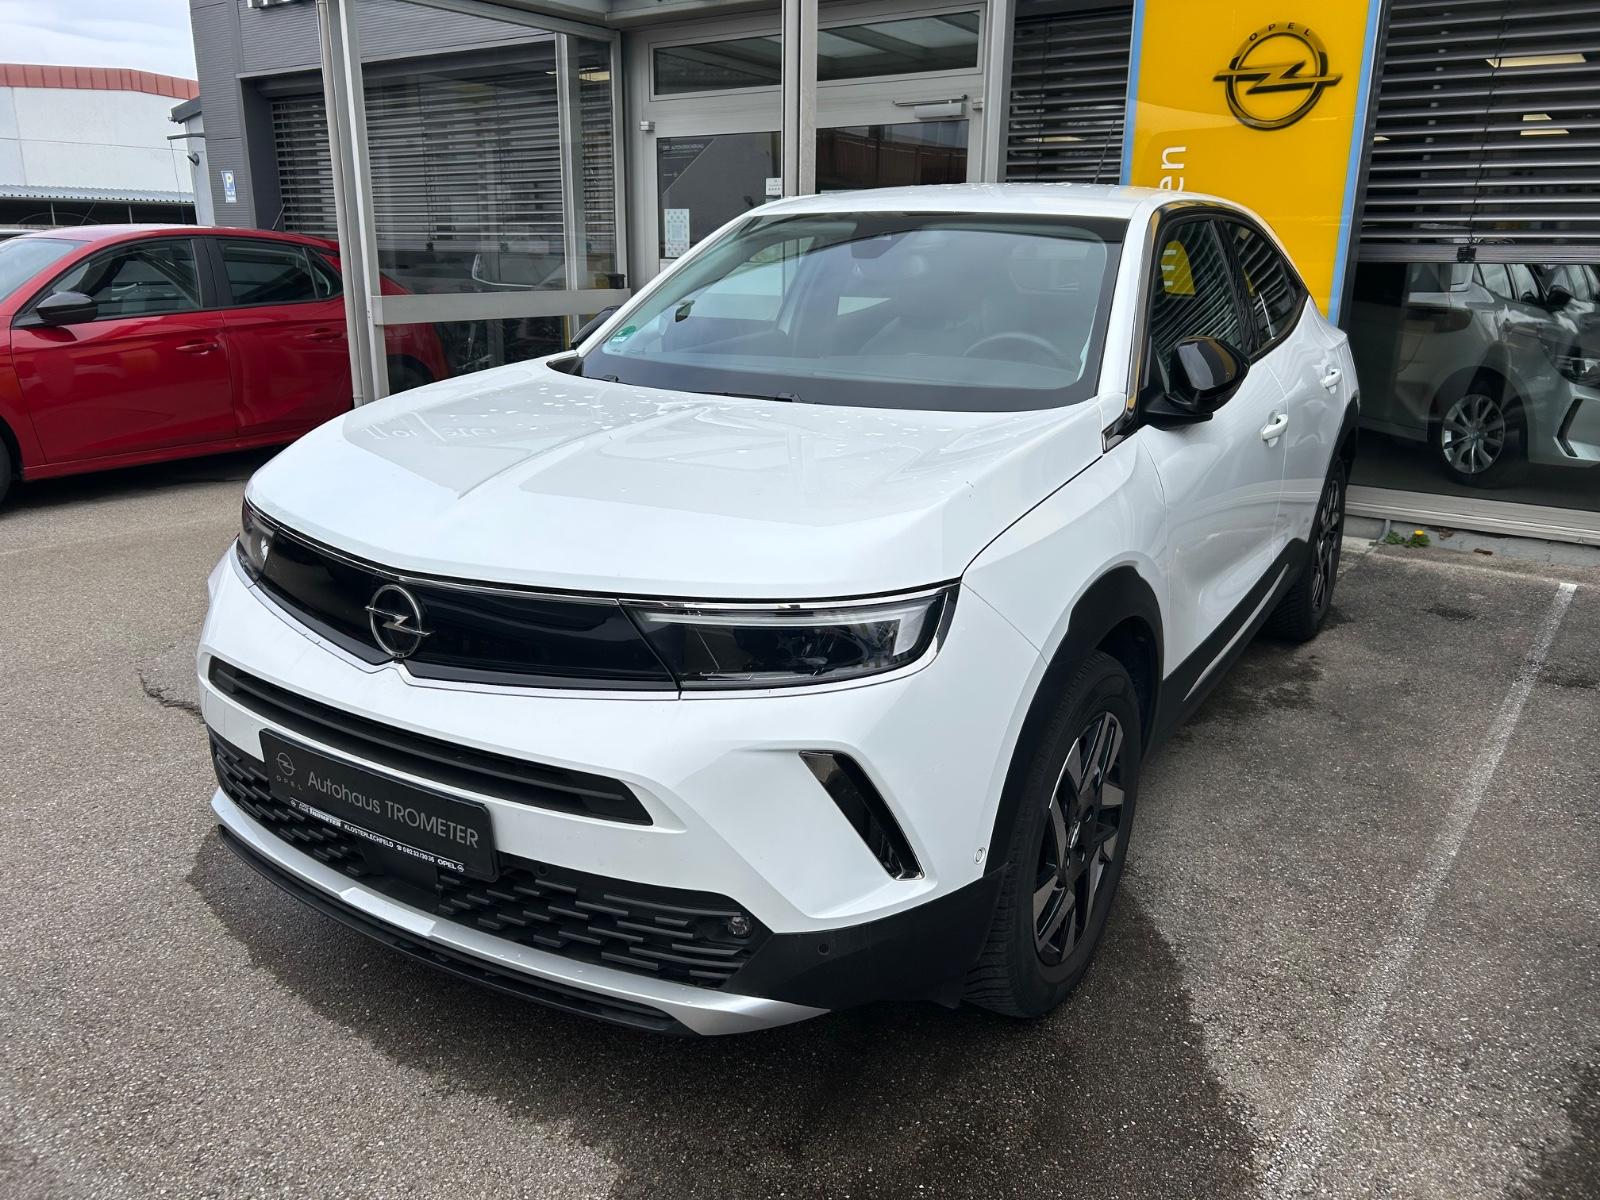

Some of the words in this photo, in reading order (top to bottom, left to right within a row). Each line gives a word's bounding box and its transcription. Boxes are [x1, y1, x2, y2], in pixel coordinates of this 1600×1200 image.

[1249, 22, 1310, 41] OPEL
[307, 771, 381, 814] Autohaus
[385, 800, 479, 848] TROMETER
[343, 823, 394, 848] KLOSTERLECHFELD
[437, 858, 457, 870] OPEL
